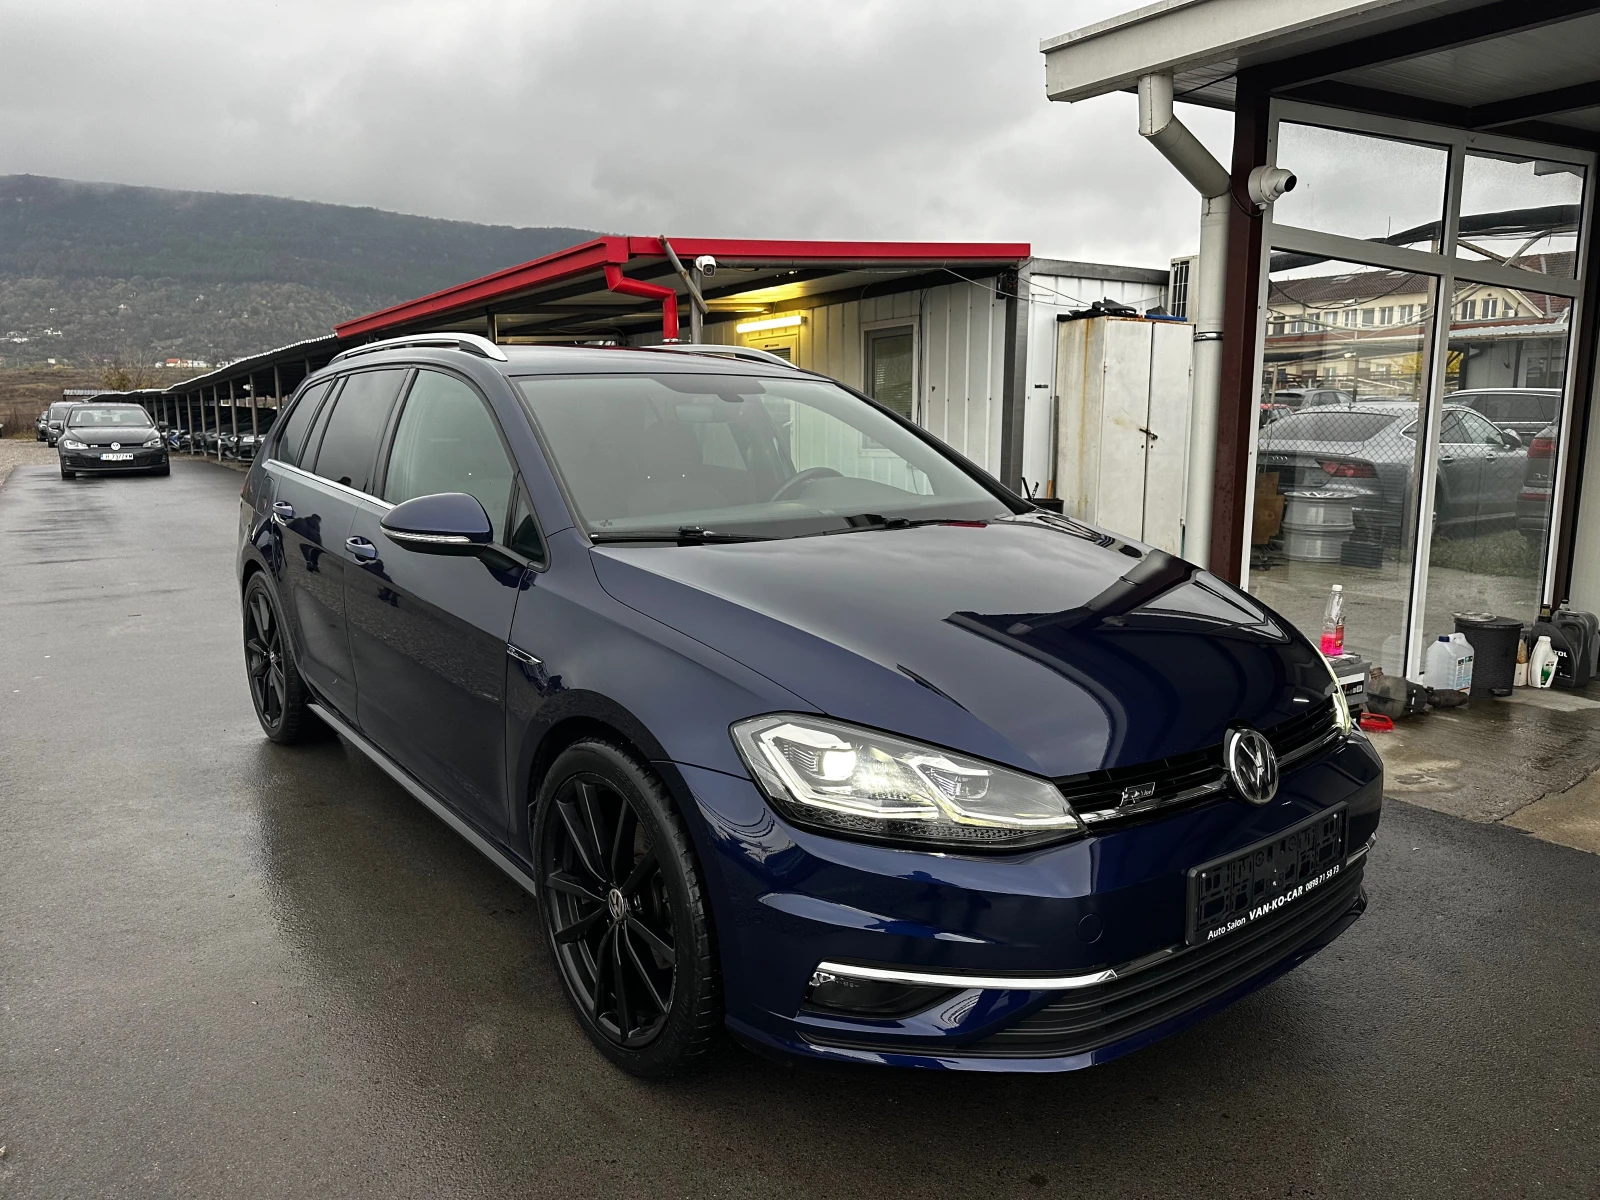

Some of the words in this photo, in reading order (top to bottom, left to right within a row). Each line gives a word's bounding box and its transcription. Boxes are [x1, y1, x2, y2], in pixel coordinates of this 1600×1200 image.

[1207, 926, 1226, 940] Auto
[1226, 917, 1246, 932] Salon
[1249, 885, 1304, 921] VAN-KO-CAR
